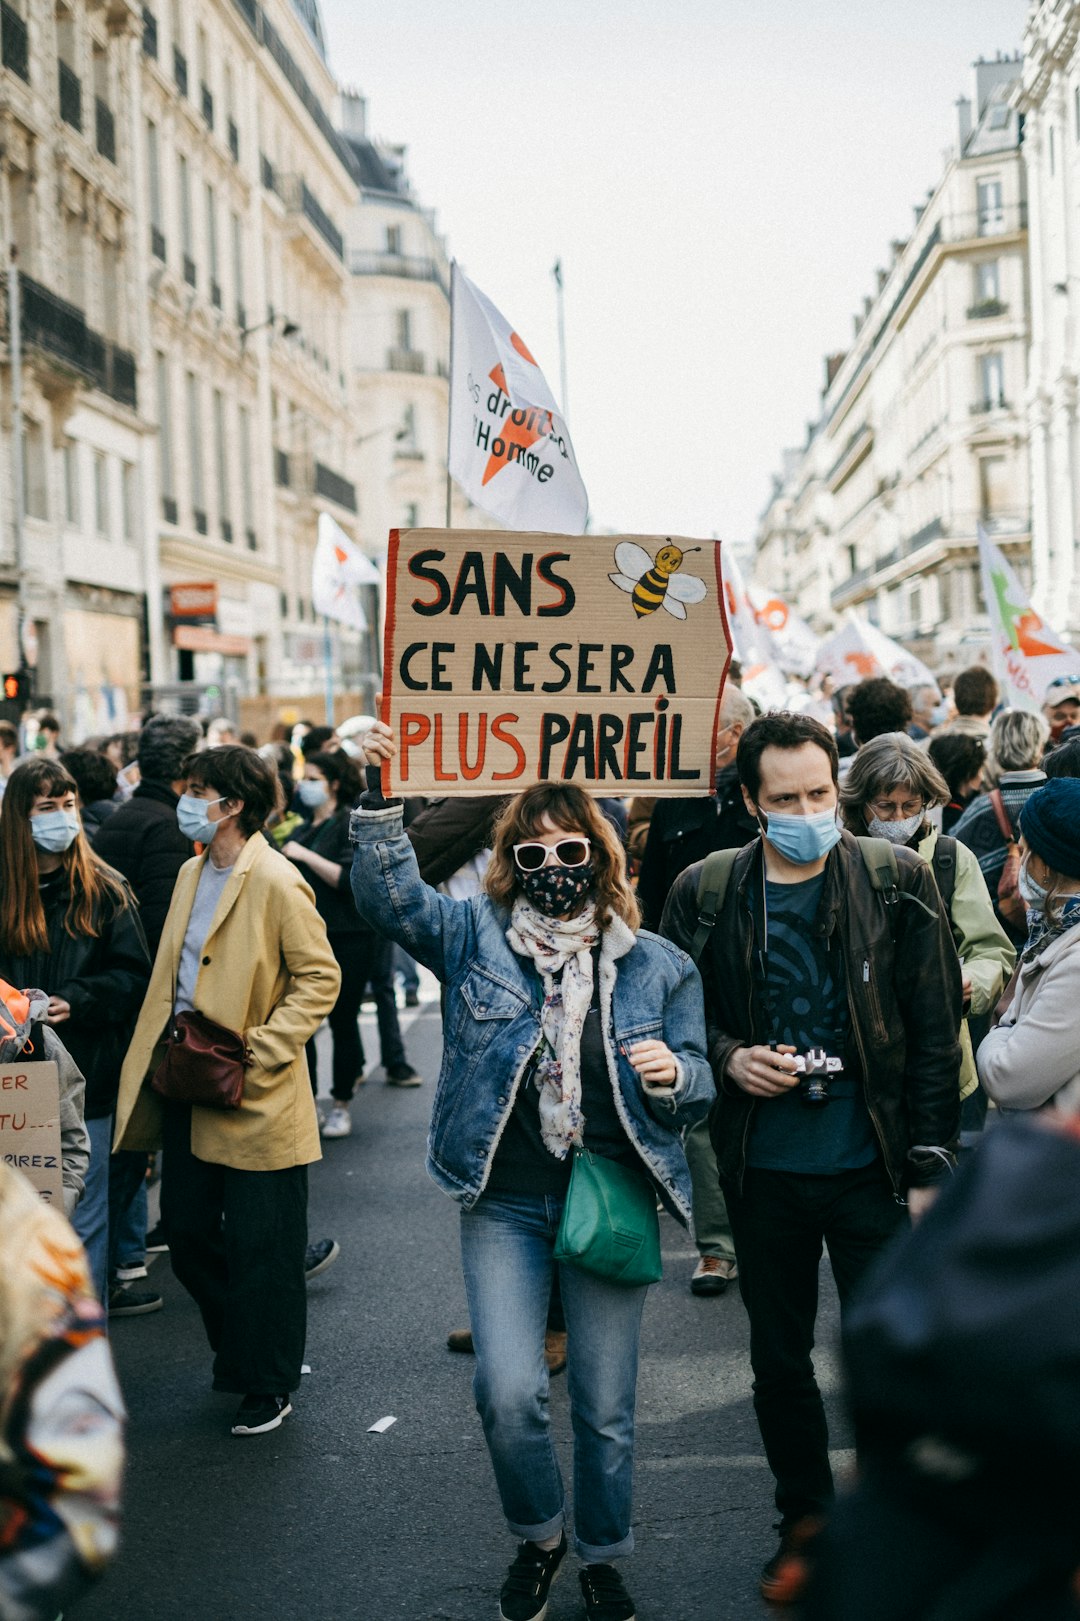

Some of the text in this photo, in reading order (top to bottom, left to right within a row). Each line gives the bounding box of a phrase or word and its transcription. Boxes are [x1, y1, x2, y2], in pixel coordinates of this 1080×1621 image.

[408, 549, 576, 617] SANS
[399, 642, 456, 692] CE
[400, 713, 526, 782] PLUS
